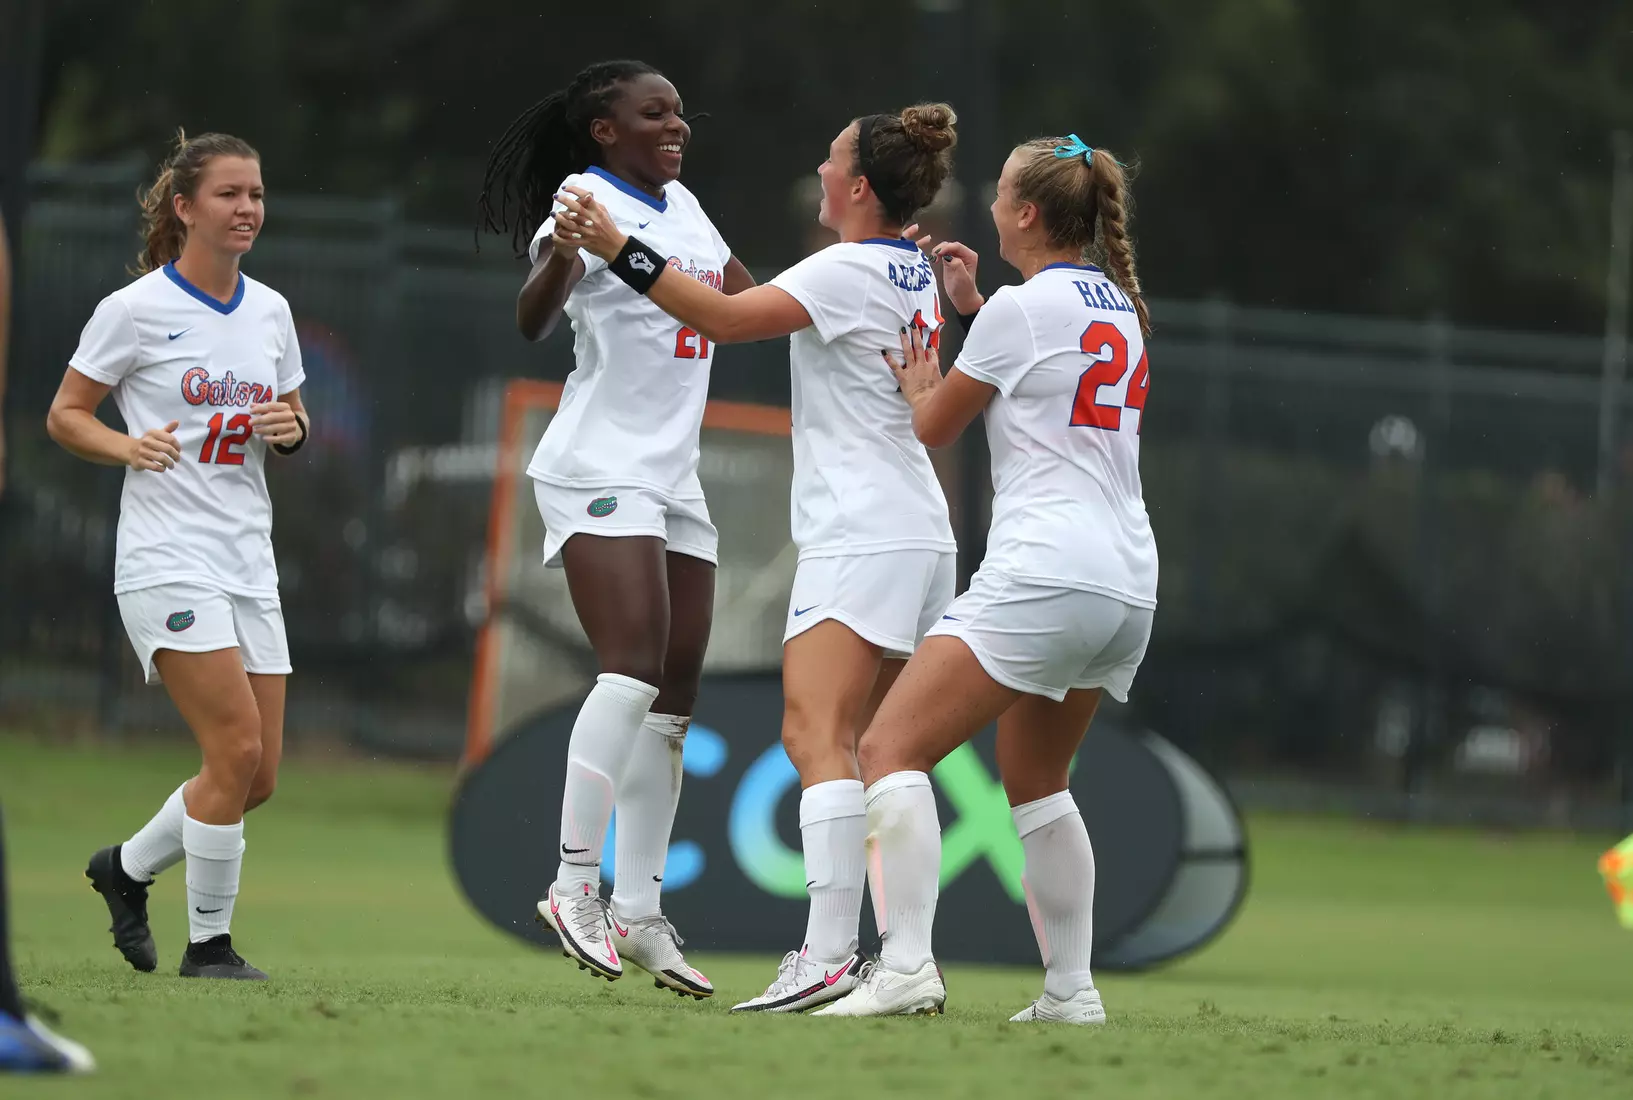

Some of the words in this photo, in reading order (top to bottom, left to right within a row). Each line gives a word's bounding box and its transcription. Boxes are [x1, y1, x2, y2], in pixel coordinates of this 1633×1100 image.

[1072, 281, 1135, 314] HALL
[181, 367, 273, 406] Gators
[1069, 320, 1150, 435] 24
[198, 412, 252, 465] 12
